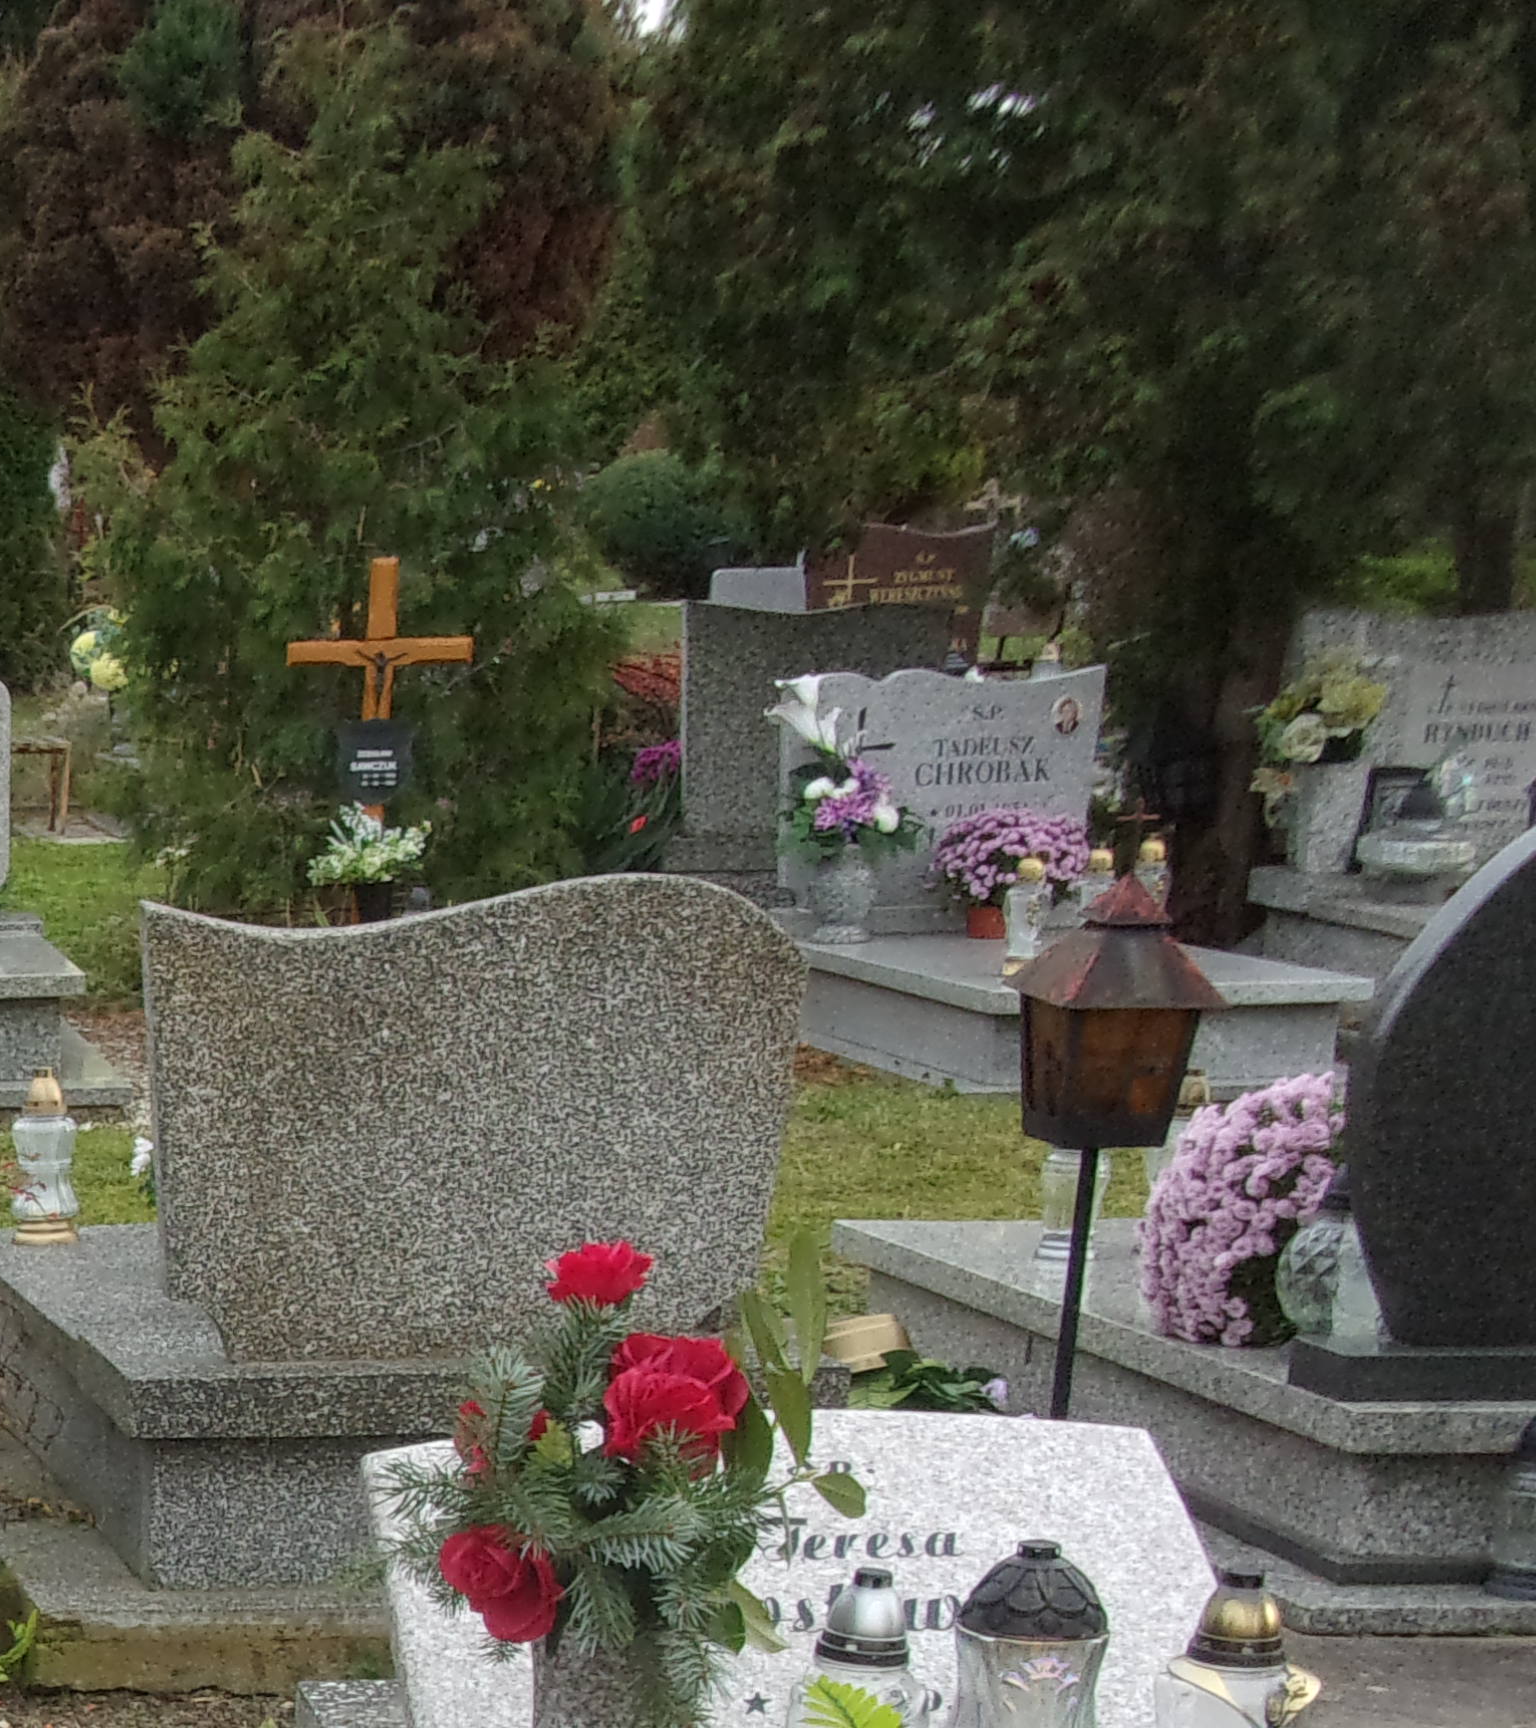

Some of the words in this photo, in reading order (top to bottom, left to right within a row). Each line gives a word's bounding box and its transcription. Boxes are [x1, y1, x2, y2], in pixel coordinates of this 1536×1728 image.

[932, 735, 1035, 758] TADEUSZ
[915, 757, 1051, 787] CHROBAK
[753, 1516, 965, 1562] Teresa
